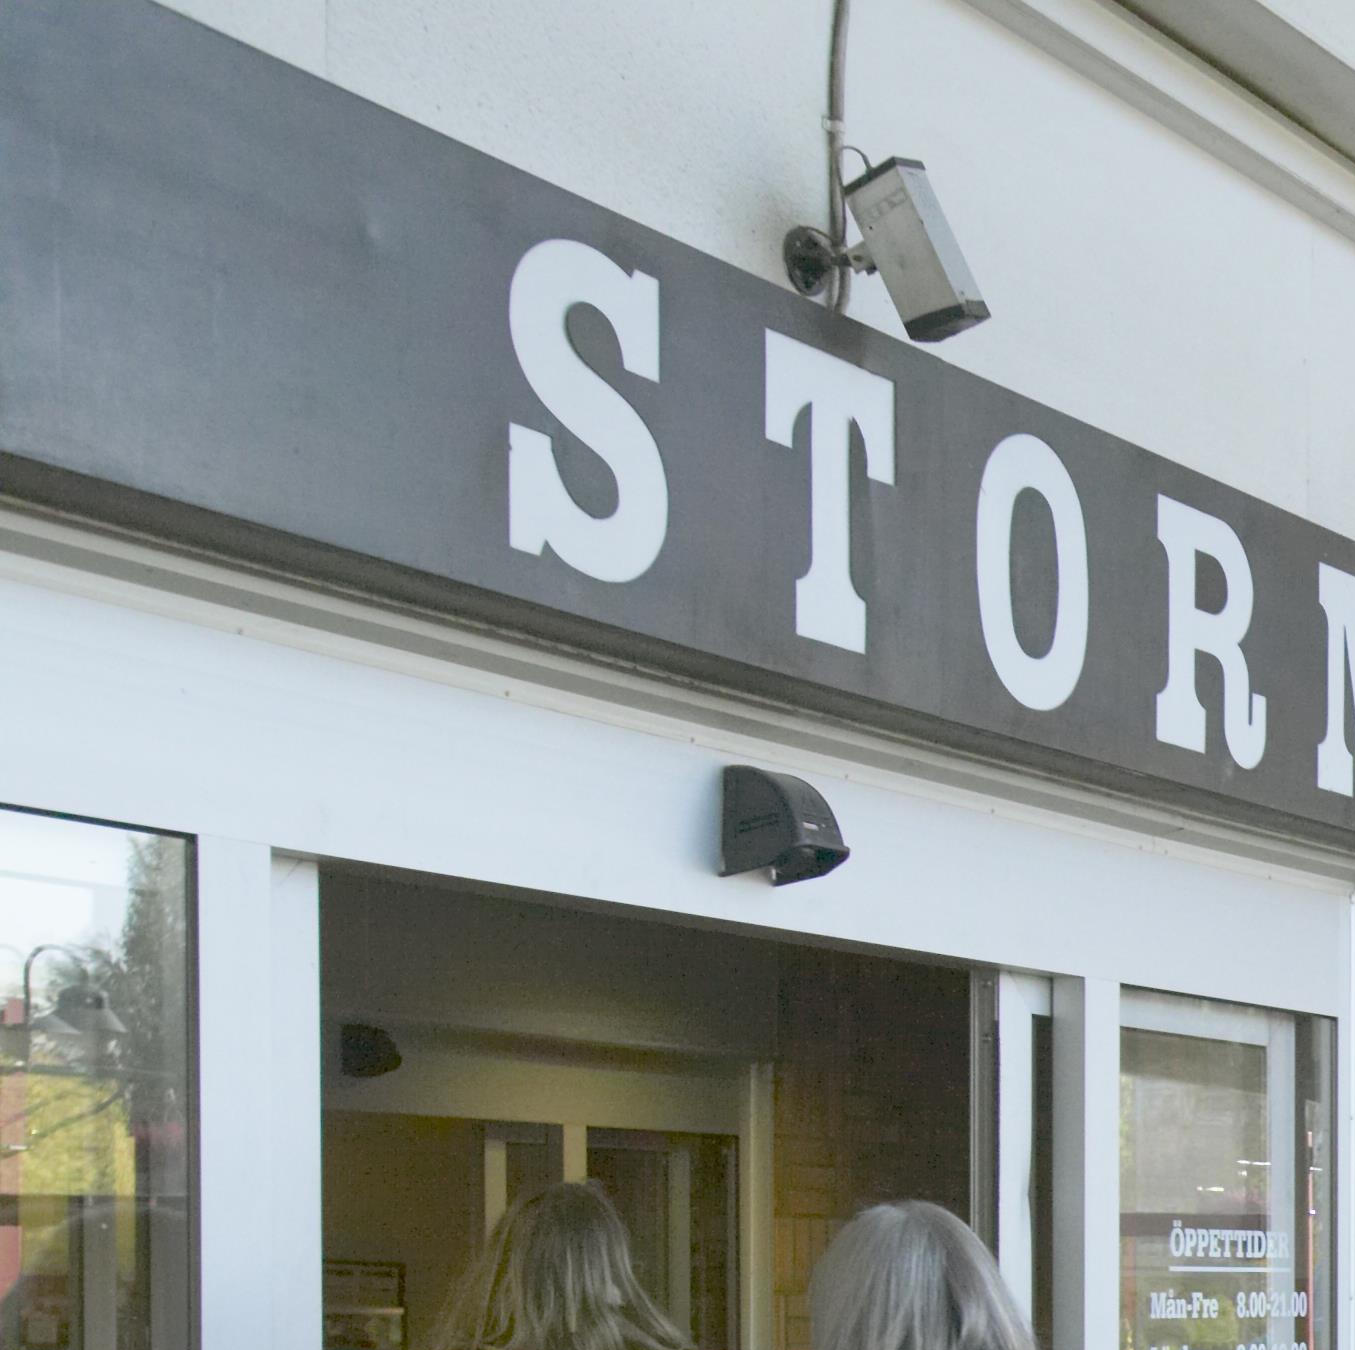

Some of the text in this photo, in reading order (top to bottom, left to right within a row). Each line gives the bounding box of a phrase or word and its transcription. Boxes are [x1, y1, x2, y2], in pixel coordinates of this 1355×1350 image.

[1169, 1220, 1290, 1258] ÖPPETTIDER
[1150, 1289, 1307, 1320] Mån-Fre 8.00-21.00
